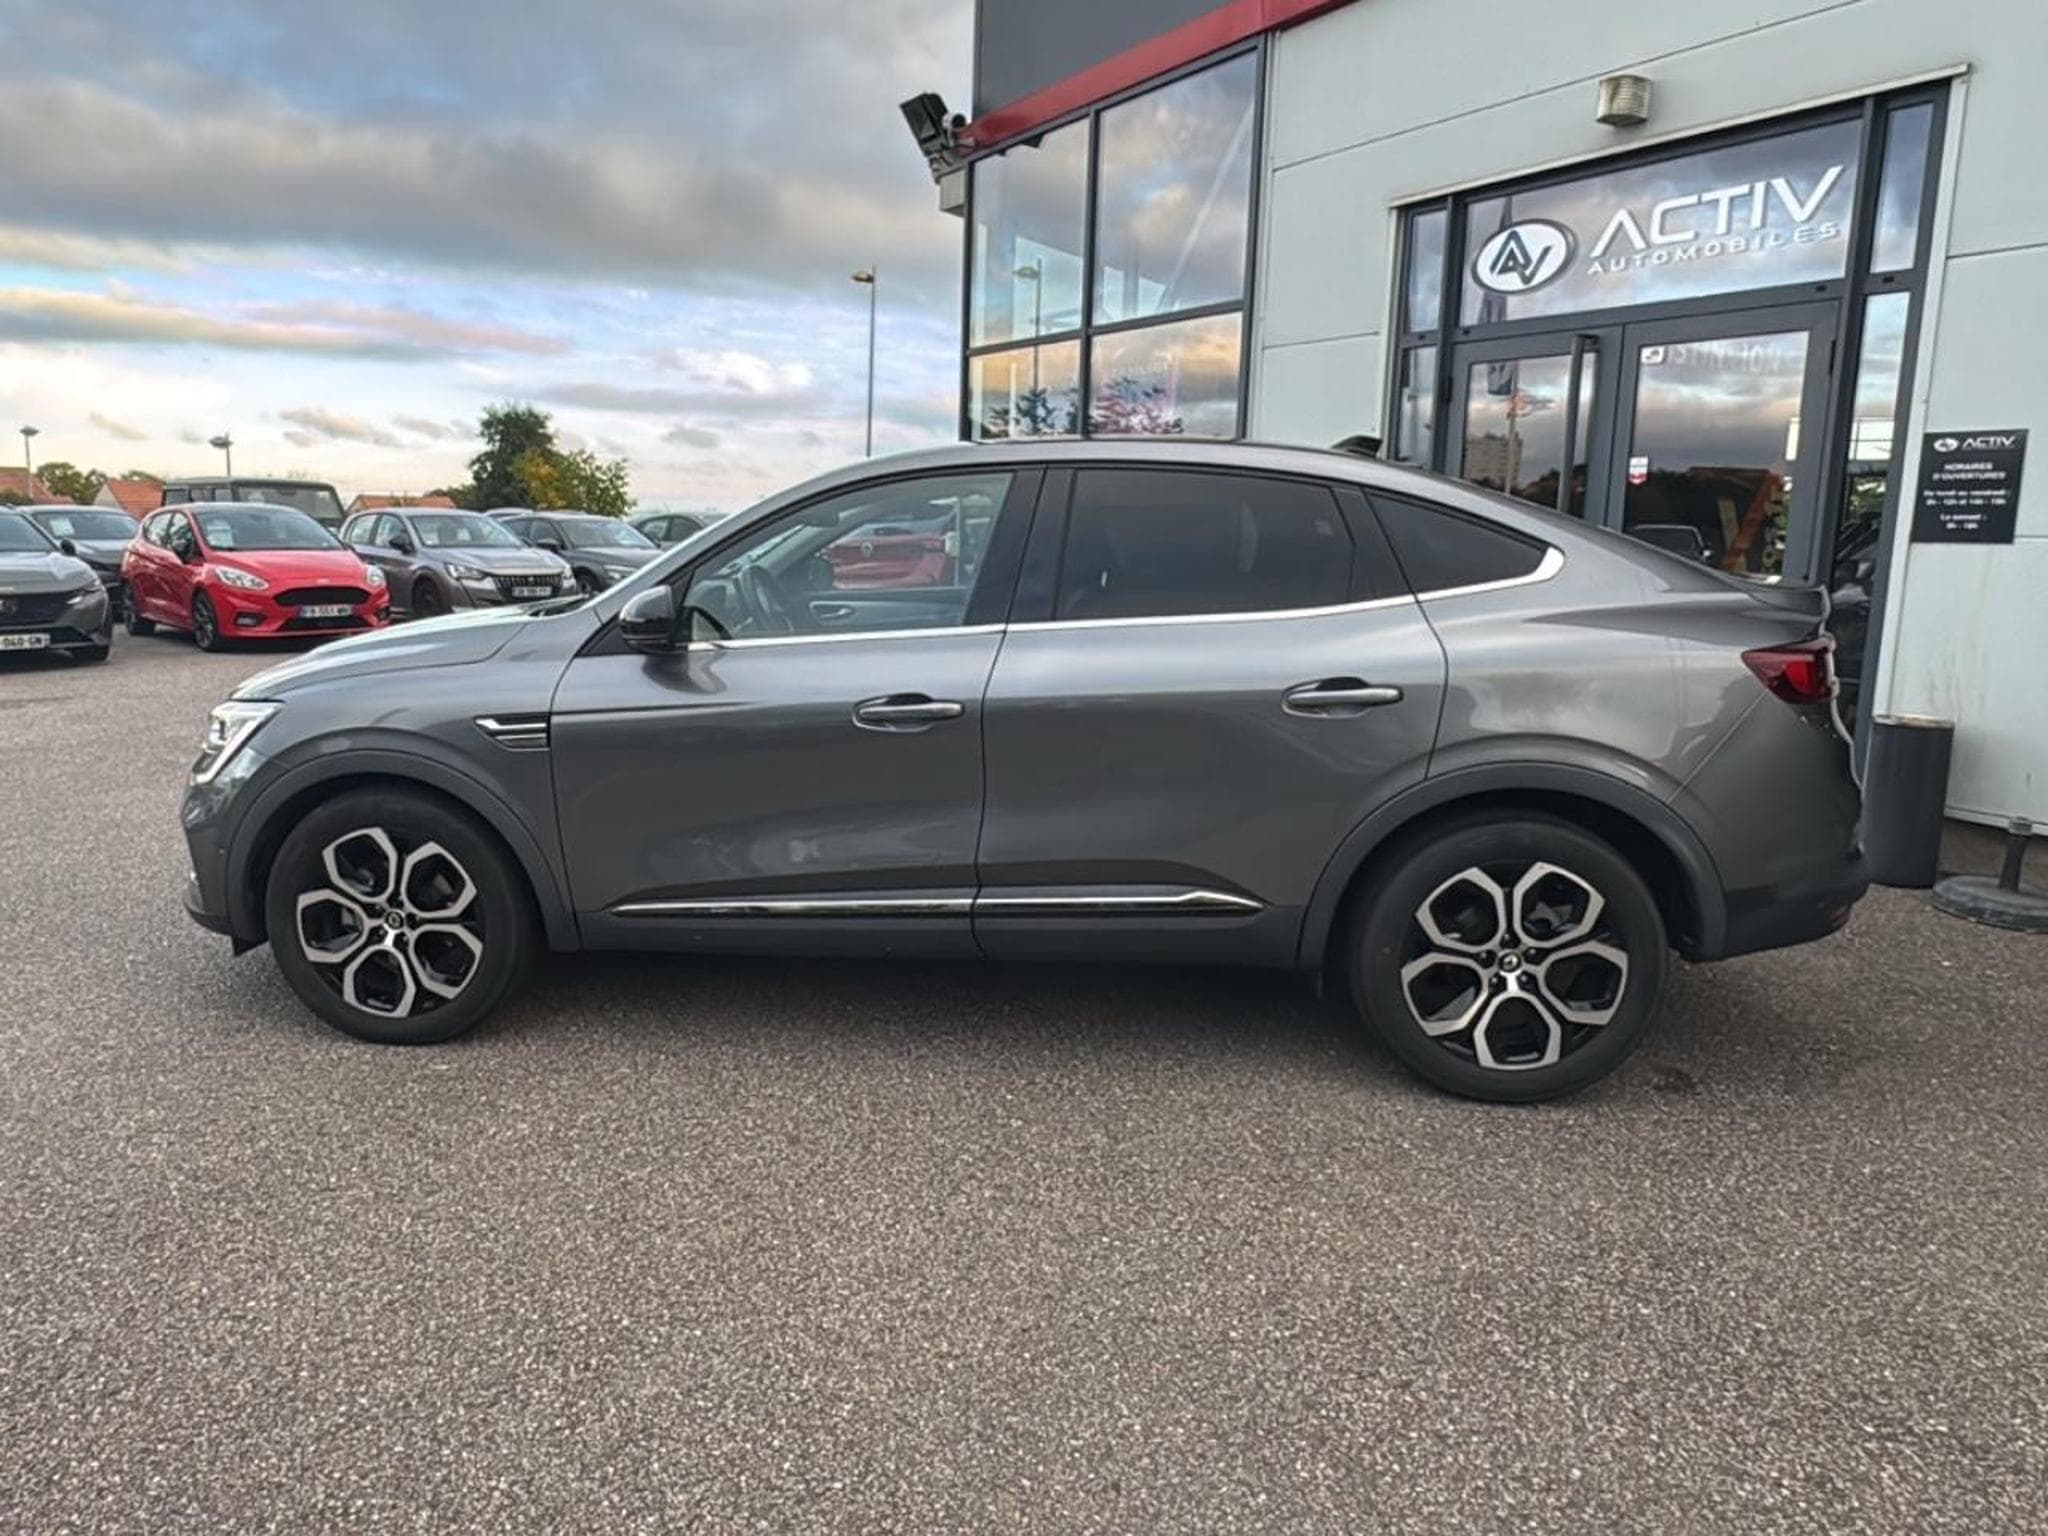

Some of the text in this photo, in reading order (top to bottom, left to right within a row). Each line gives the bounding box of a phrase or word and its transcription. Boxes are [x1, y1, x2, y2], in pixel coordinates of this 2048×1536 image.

[1589, 165, 1844, 257] ACTIV
[1587, 220, 1840, 276] AUTOMOBILES
[1962, 435, 2016, 449] ACTIV
